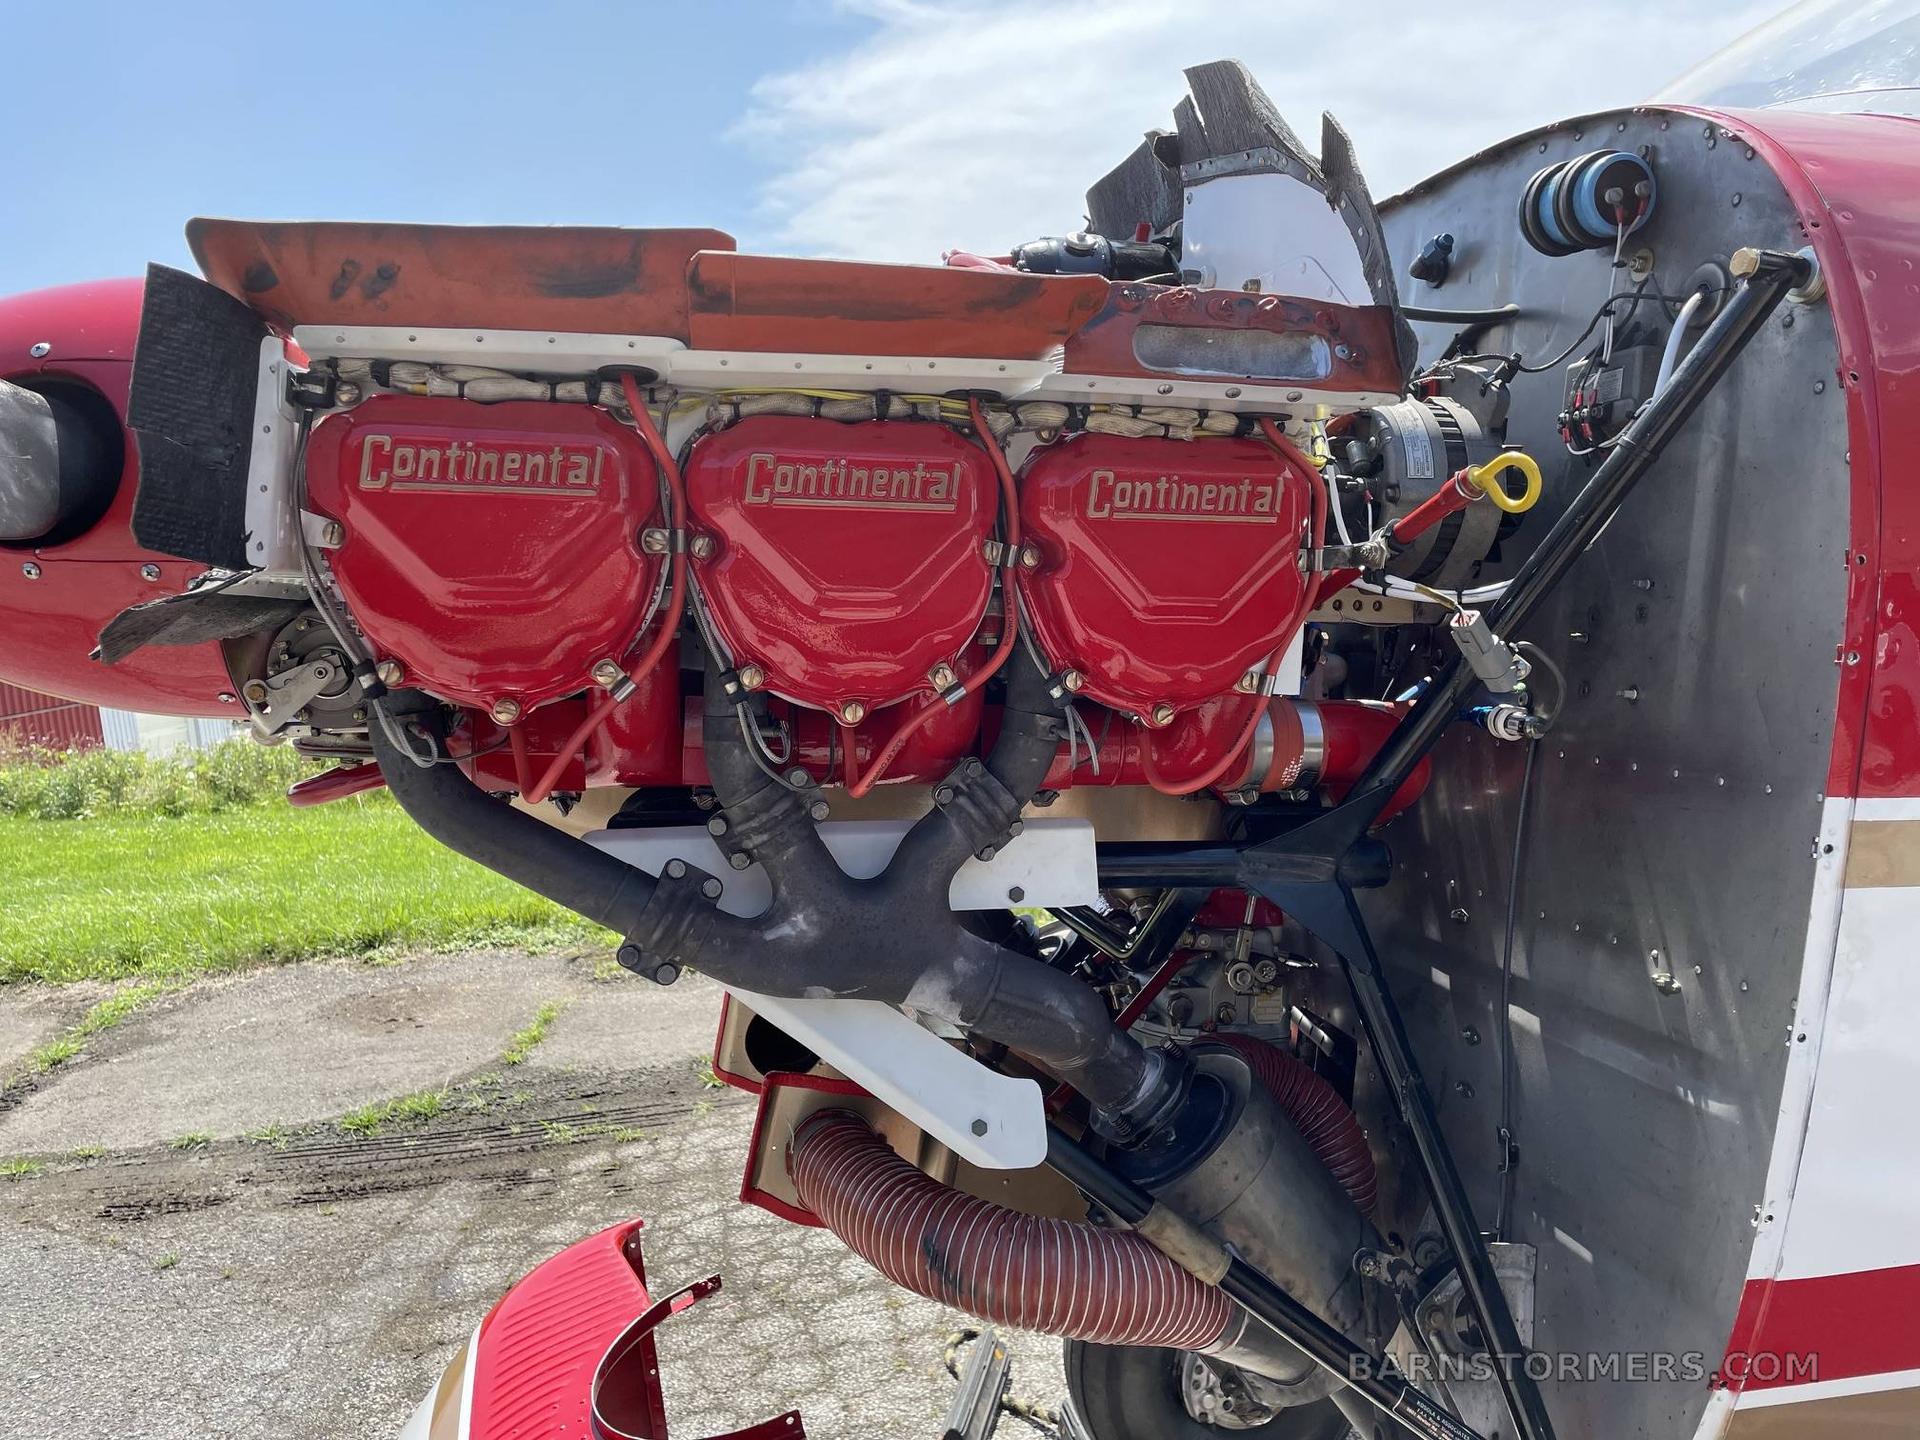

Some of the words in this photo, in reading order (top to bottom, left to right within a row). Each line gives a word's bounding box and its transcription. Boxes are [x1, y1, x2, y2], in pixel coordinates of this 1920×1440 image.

[359, 434, 603, 489] Continental
[745, 453, 962, 504] Continental
[1086, 470, 1285, 519] Continental
